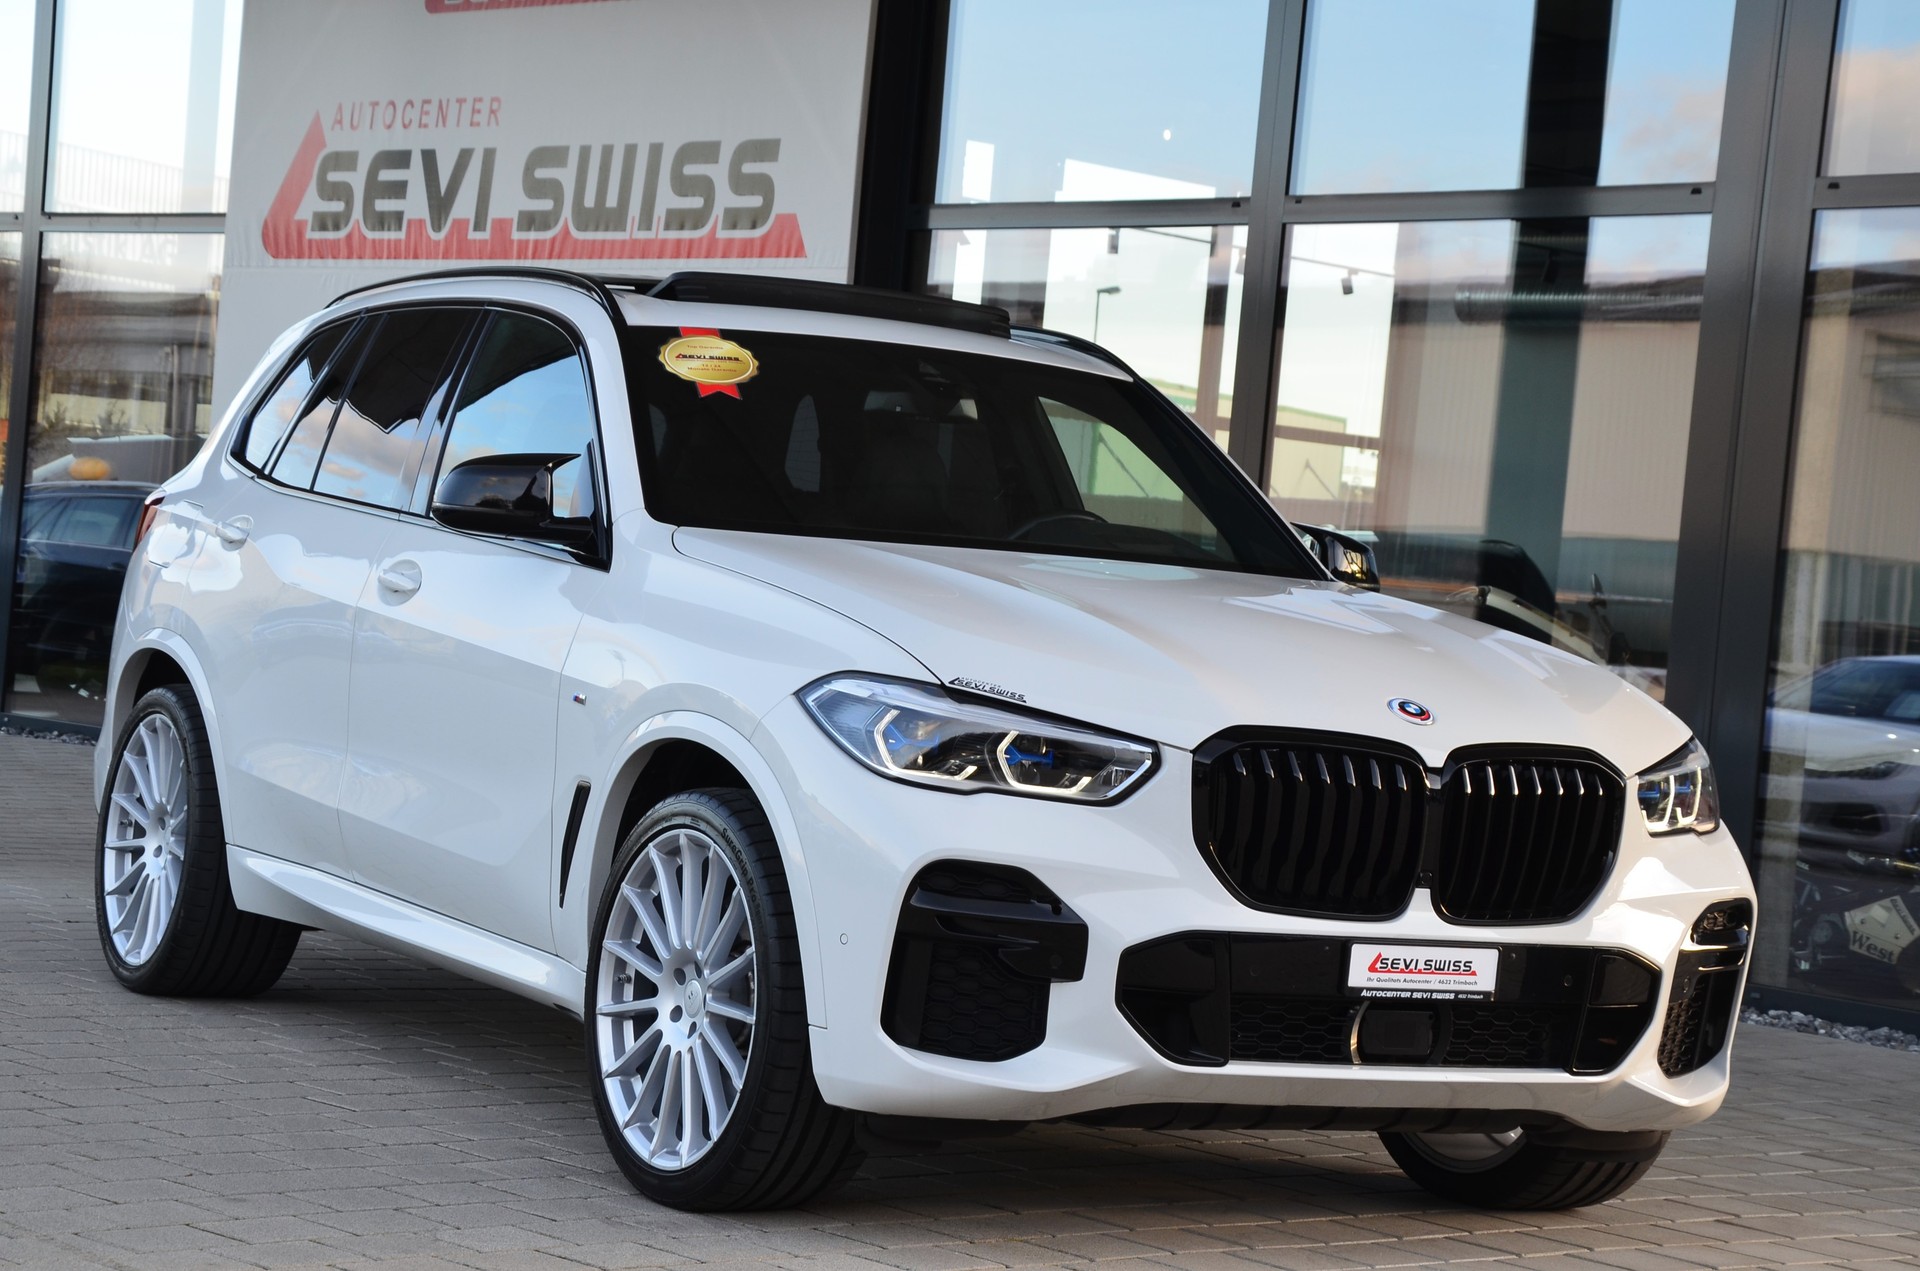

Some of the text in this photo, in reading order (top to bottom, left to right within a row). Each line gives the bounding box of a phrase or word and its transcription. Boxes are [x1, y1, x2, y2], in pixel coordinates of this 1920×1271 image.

[331, 96, 502, 131] AUTOCENTER
[310, 138, 782, 233] SEVI SWISS
[956, 679, 1026, 701] SEVI SWISS
[720, 827, 749, 877] SureGrip
[1852, 930, 1894, 962] West
[1379, 957, 1473, 972] SEVI SWISS
[1361, 989, 1411, 998] AUTOCENTER
[1412, 991, 1430, 999] SEVI
[1431, 992, 1455, 1000] SWISS
[1402, 977, 1432, 985] Autocenter
